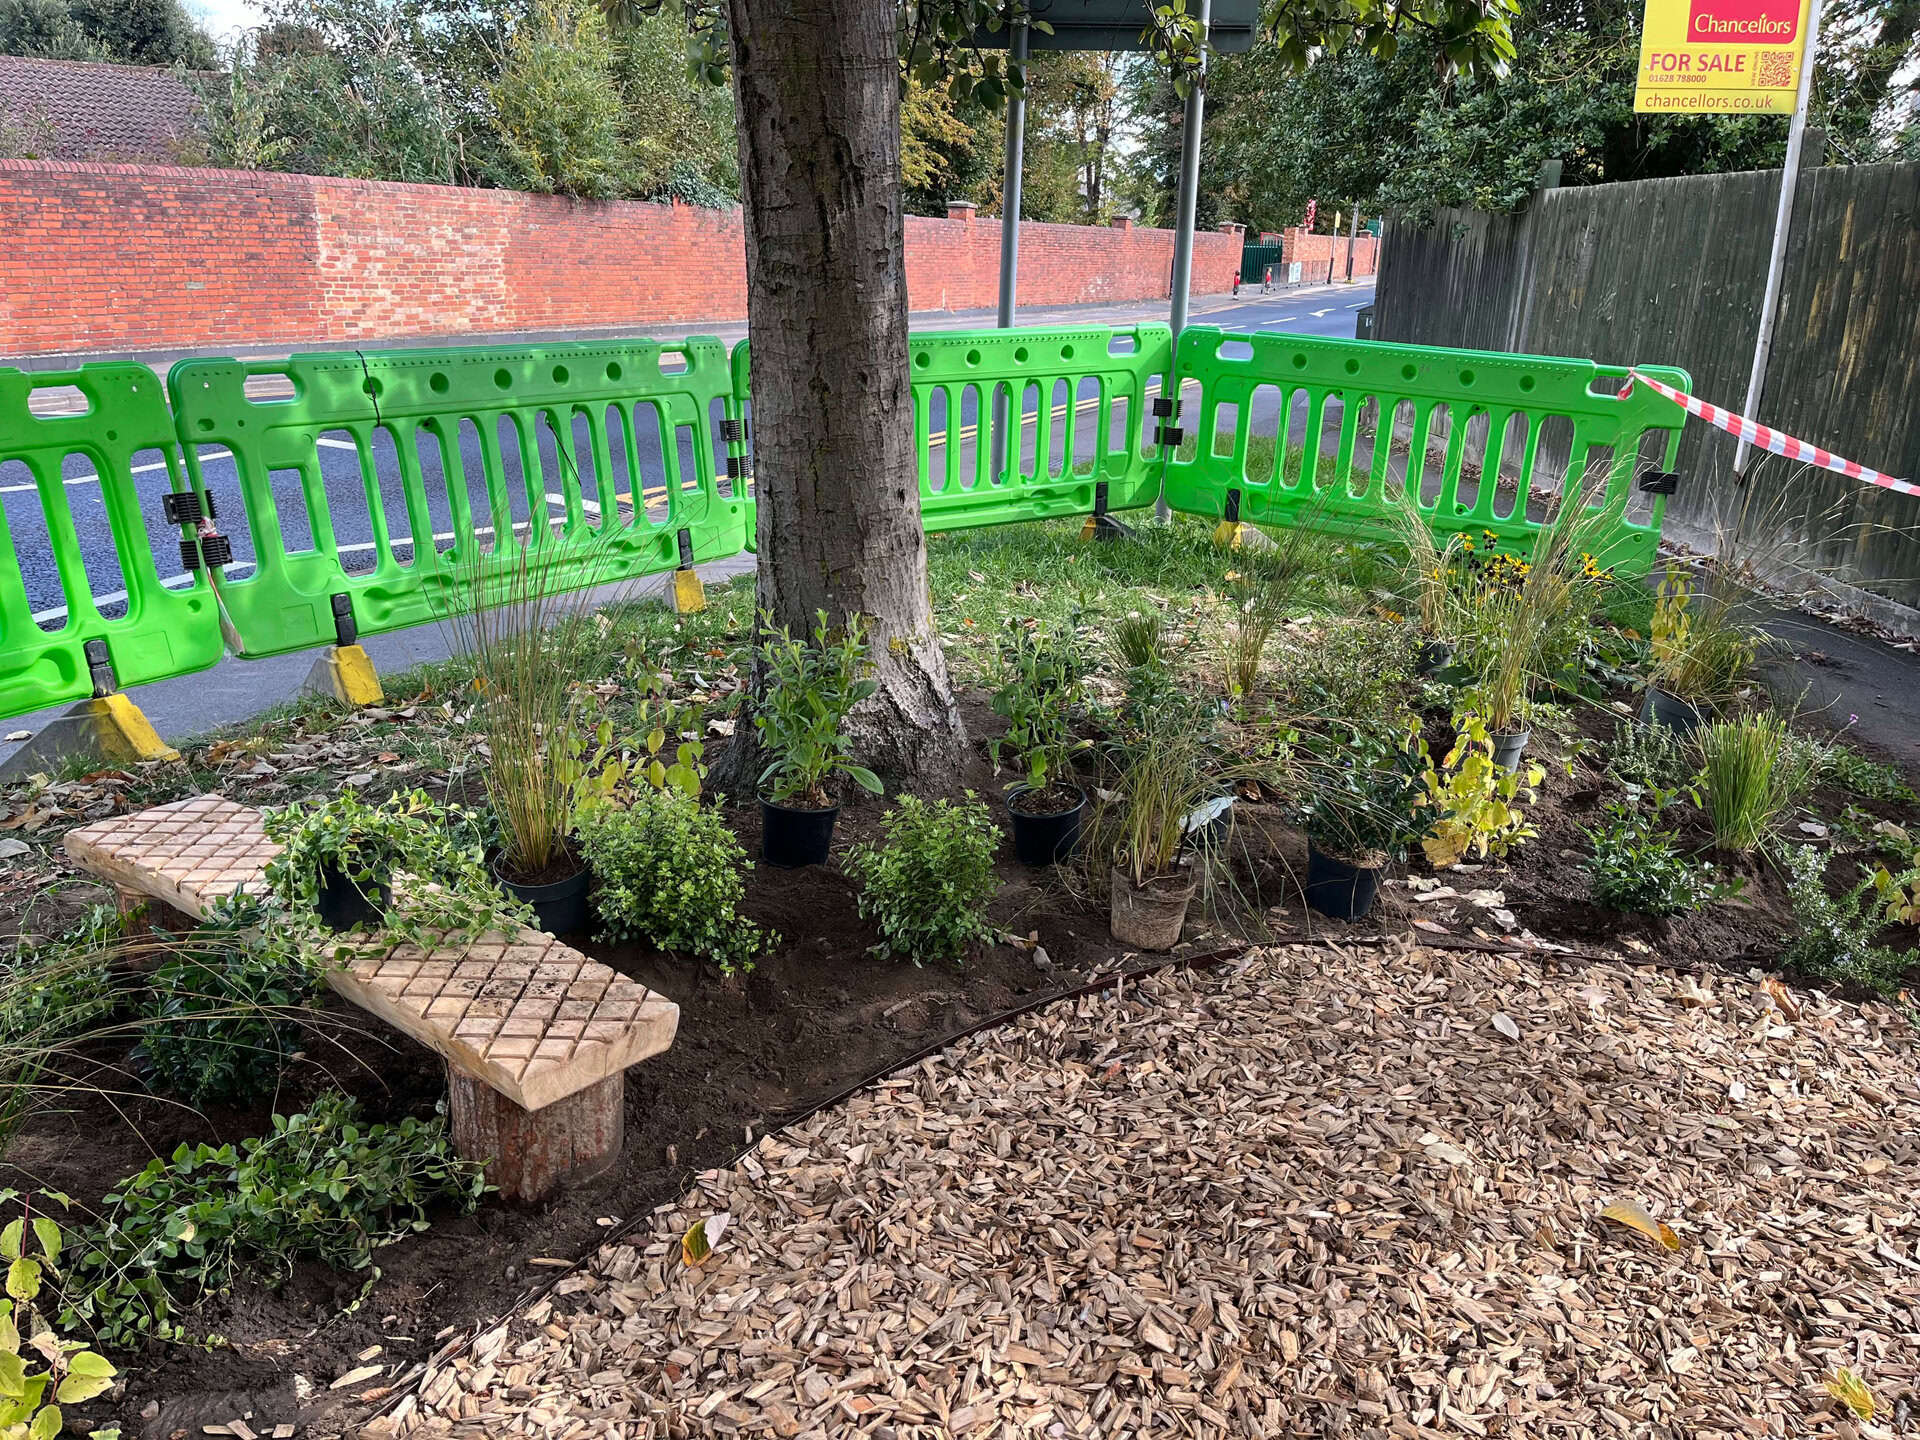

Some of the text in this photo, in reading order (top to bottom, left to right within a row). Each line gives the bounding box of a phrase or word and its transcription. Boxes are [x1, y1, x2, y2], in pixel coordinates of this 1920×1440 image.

[1694, 13, 1791, 34] Chancellors
[1650, 53, 1746, 73] FOR SALE
[1648, 74, 1707, 83] 01628 788000
[1645, 93, 1772, 109] chancellors.co.uk
